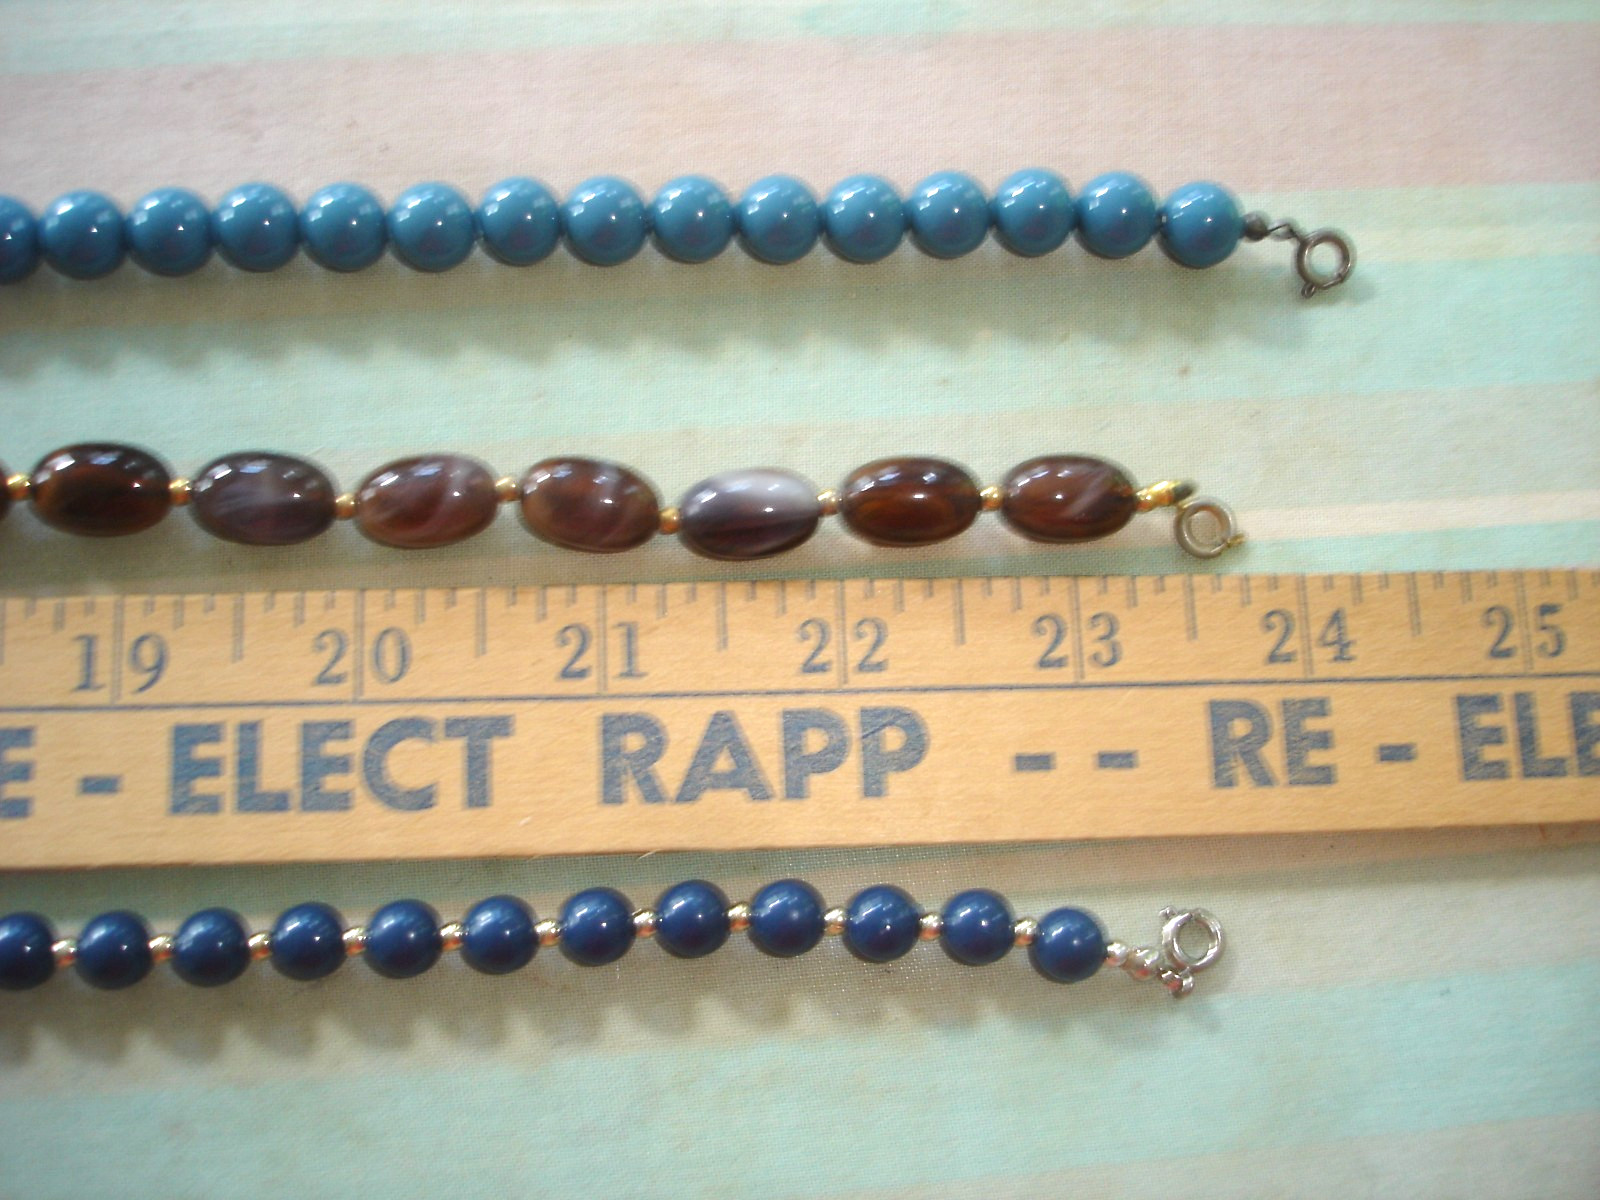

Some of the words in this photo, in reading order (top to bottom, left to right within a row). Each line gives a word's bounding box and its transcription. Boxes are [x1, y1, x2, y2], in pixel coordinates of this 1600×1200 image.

[73, 630, 171, 694] 19
[311, 627, 413, 686] 20
[556, 621, 648, 680] 21
[799, 617, 889, 674] 22
[1033, 611, 1123, 669] 23
[1260, 608, 1356, 665] 24
[1481, 603, 1567, 660] 25
[168, 714, 515, 815] ELECT
[599, 705, 930, 805] RAPP
[1208, 696, 1338, 789] RE
